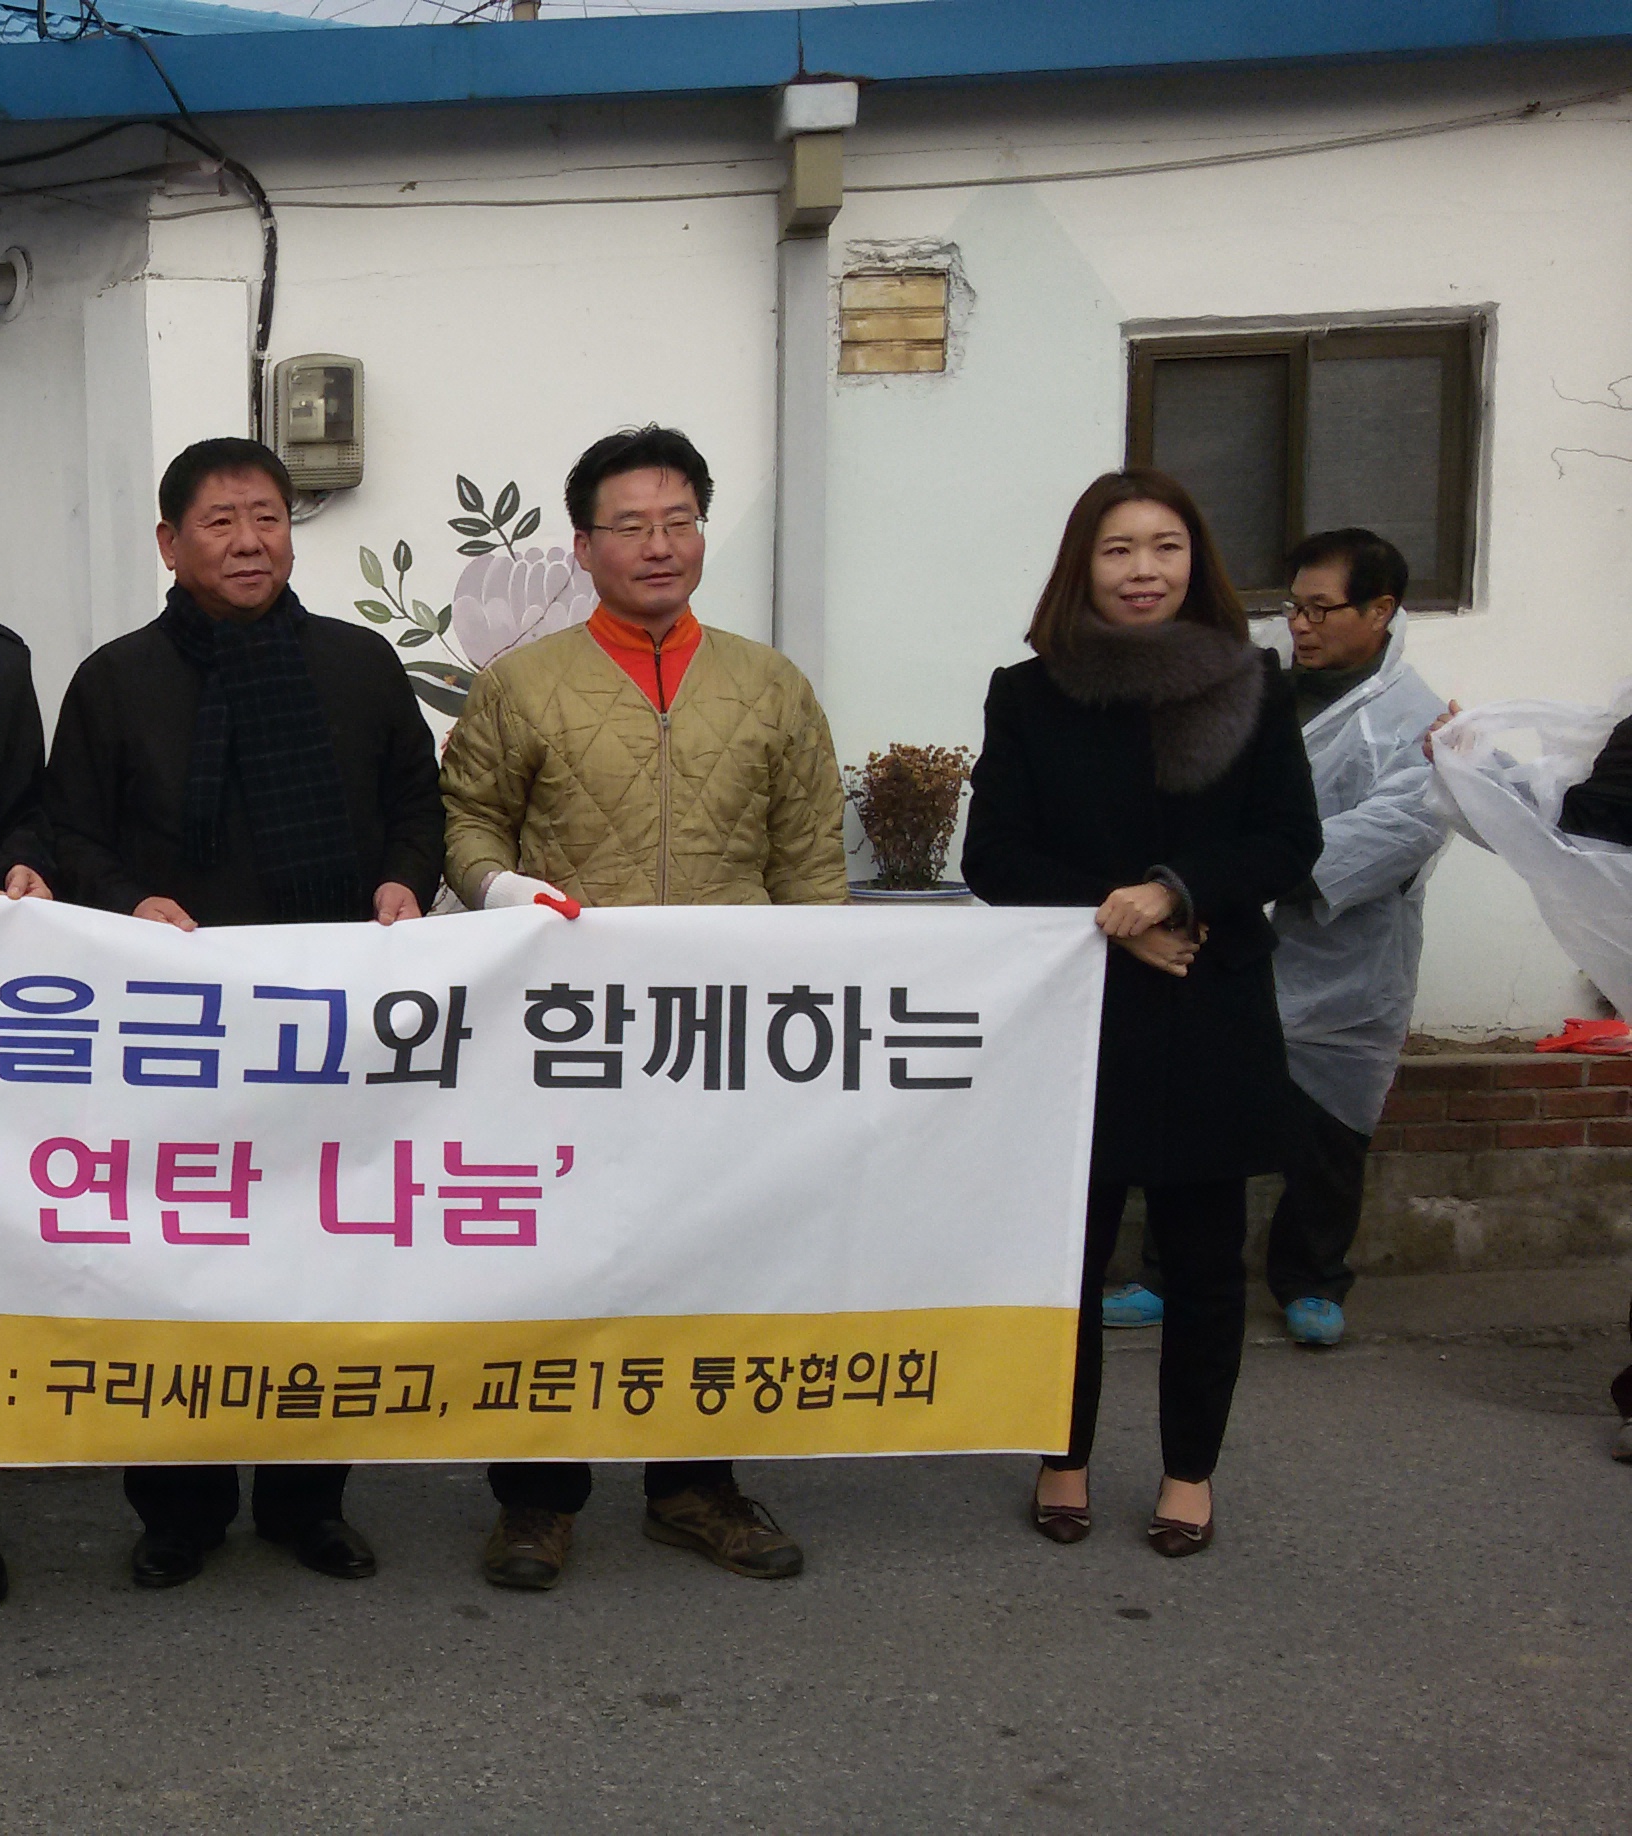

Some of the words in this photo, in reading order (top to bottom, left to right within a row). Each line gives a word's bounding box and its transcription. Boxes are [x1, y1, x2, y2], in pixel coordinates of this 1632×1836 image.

[524, 983, 983, 1091] 함께하는
[30, 1137, 263, 1246] 연탄
[46, 1360, 449, 1420] 구리새마을금고,
[472, 1357, 665, 1416] 교문1동
[690, 1349, 938, 1416] 통장협의회
